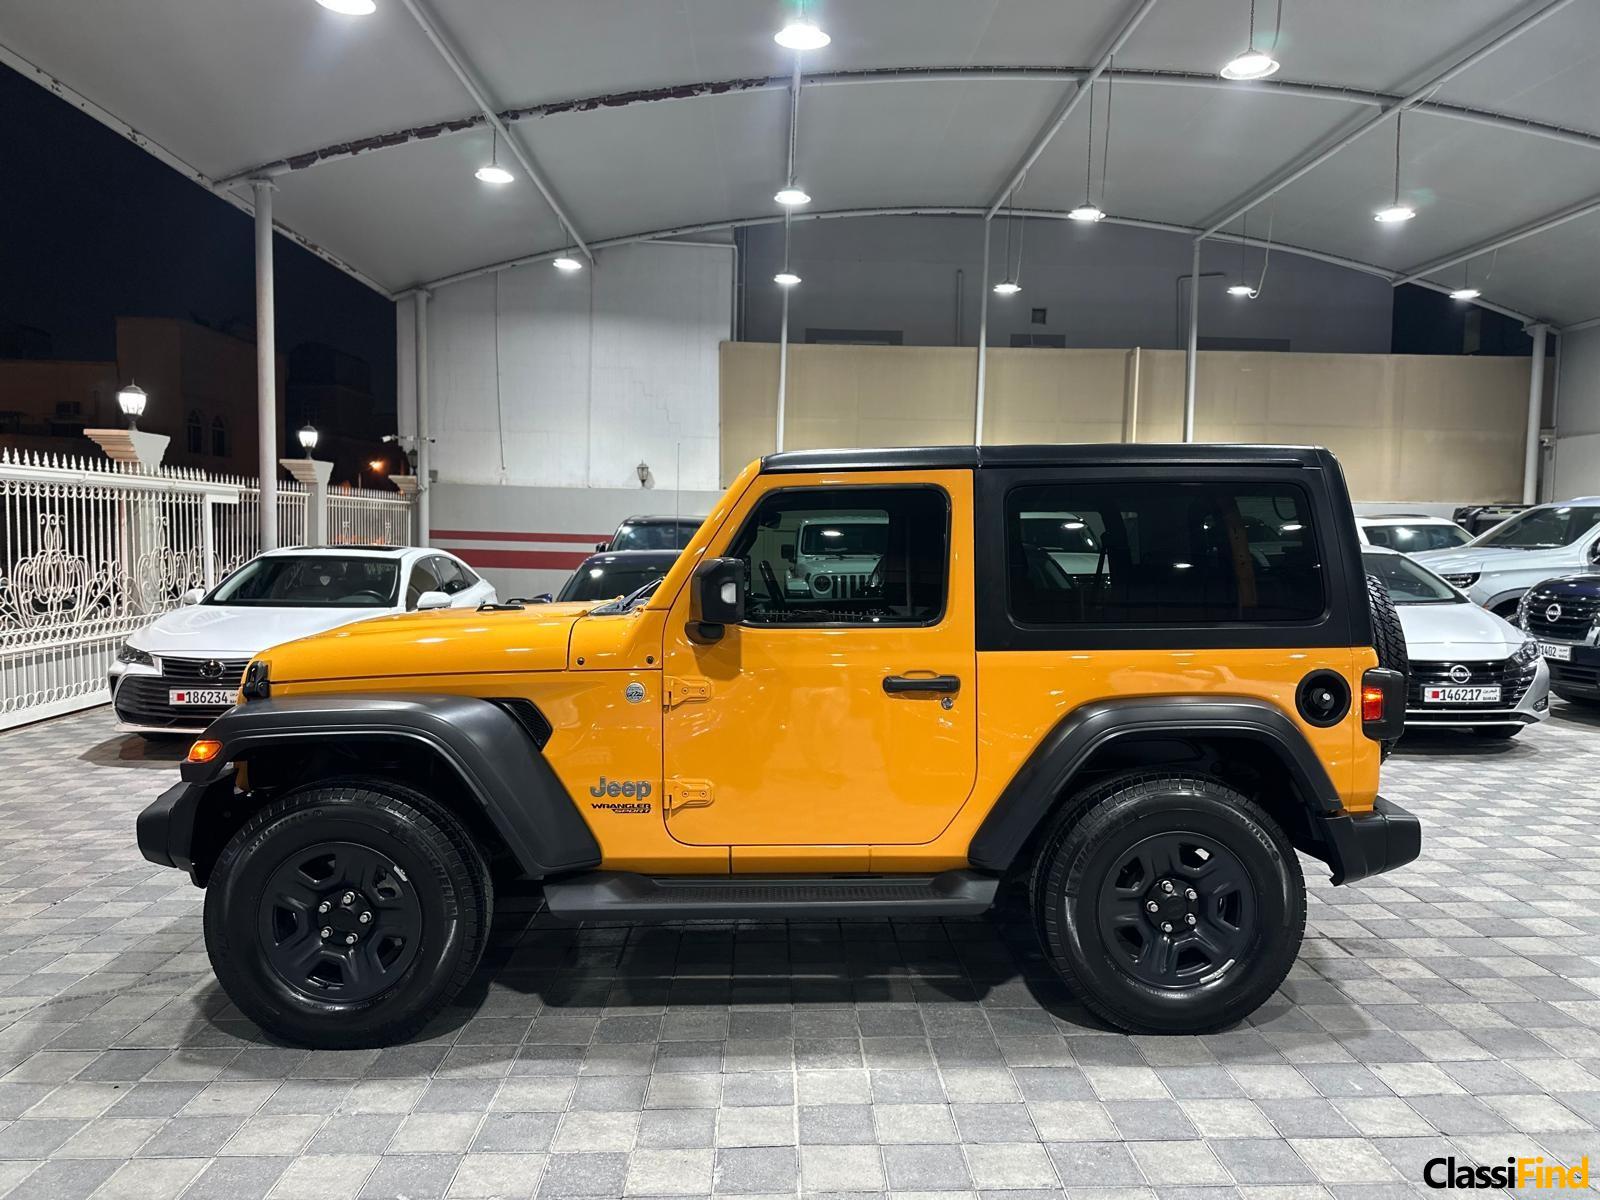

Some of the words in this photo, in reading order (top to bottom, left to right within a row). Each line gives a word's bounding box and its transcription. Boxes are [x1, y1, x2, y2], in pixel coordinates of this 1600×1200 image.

[185, 691, 228, 704] 186234
[1440, 689, 1482, 701] 146217
[590, 776, 652, 801] Jeep
